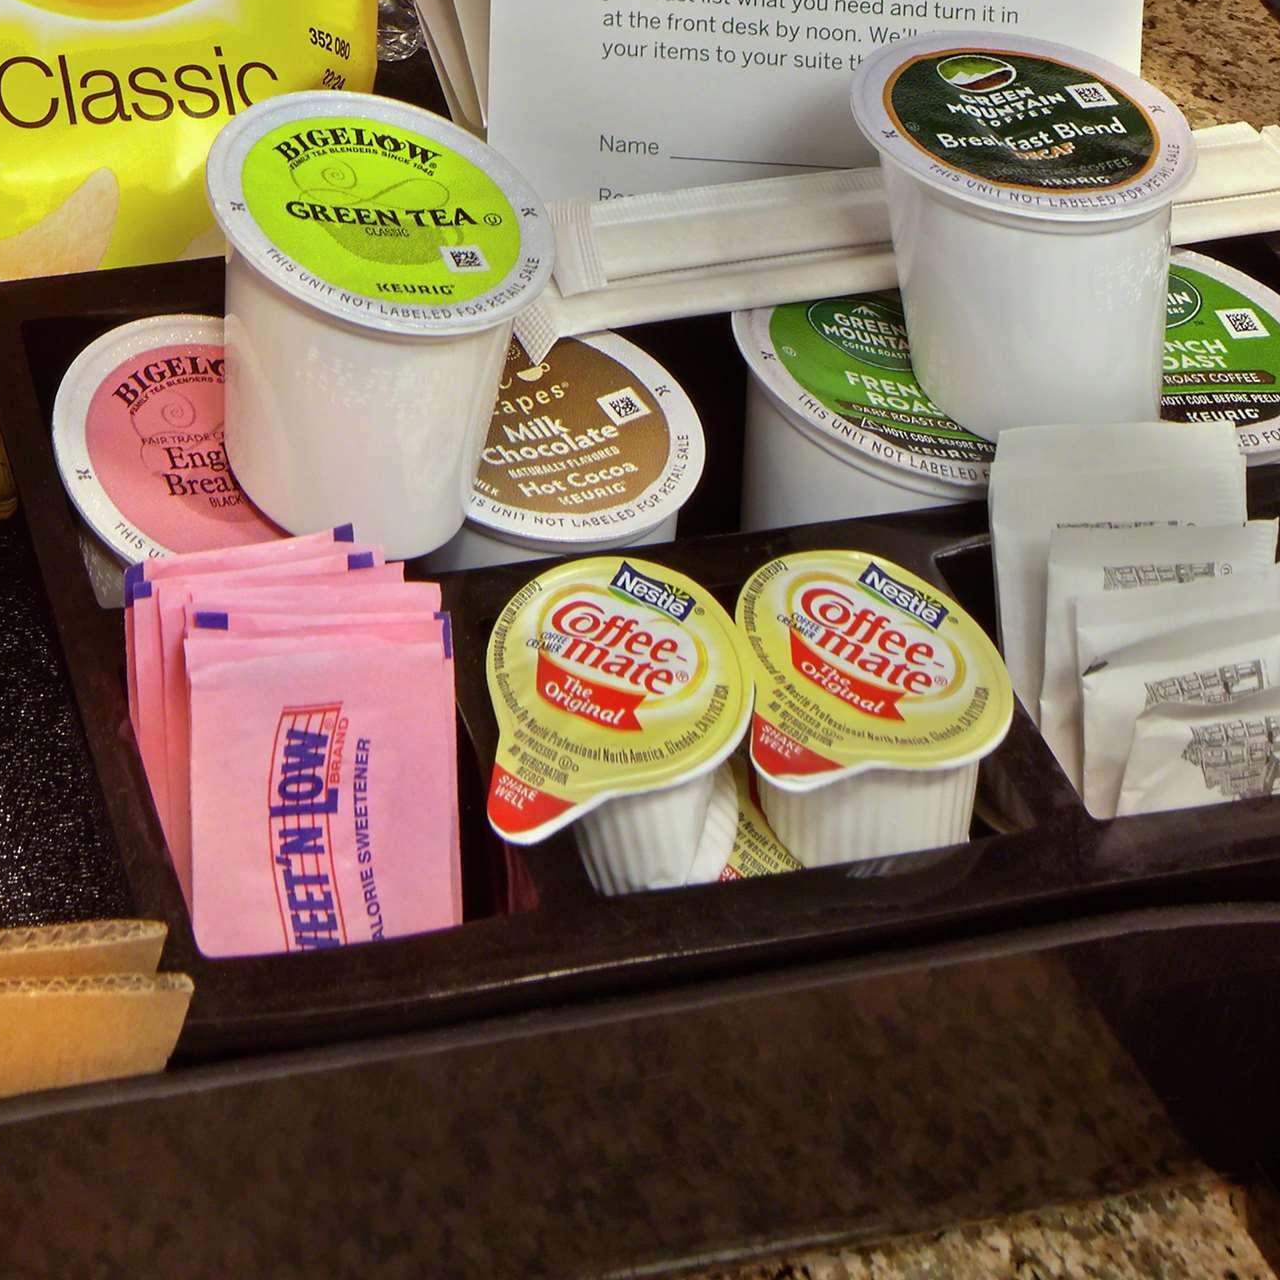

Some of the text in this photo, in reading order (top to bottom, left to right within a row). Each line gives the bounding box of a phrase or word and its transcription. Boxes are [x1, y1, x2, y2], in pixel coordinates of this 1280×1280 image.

[602, 10, 862, 43] at the front desk by noon.
[890, 1, 928, 18] and
[934, 2, 976, 21] turn
[982, 4, 996, 23] it
[1001, 6, 1019, 24] in
[308, 27, 351, 61] 352 080
[601, 41, 843, 70] your items to your suite
[946, 92, 1068, 118] MOUNTAIN
[959, 86, 1036, 108] GREEN
[1052, 116, 1127, 140] Blend
[272, 126, 442, 164] BIGELOW
[600, 134, 660, 156] Name
[285, 200, 478, 228] GREEN TEA
[266, 246, 541, 320] THIS UNIT NOT LABELED FOR RETAIL SALE
[376, 282, 452, 296] KEURIG
[833, 312, 907, 337] GREEN
[1164, 372, 1262, 385] ROAST COFFEE
[1187, 394, 1214, 405] COOL
[1215, 393, 1252, 405] BEFORE
[502, 415, 569, 444] Milk
[891, 410, 935, 428] ROAST
[169, 432, 212, 445] TRADE
[480, 424, 620, 467] Chocolate
[508, 445, 621, 480] NATURALLY FLAVORED
[518, 462, 639, 499] Hot Cocoa
[558, 483, 624, 507] KEURIG
[616, 570, 688, 620] Nestlé
[865, 570, 939, 624] Nestlé
[551, 600, 688, 663] Coffee-
[776, 613, 817, 640] CREAMER
[791, 611, 821, 634] COFFEE
[801, 587, 945, 668] Coffee-
[561, 637, 675, 695] mate
[815, 627, 933, 695] mate
[819, 663, 851, 687] The
[563, 674, 594, 698] The
[800, 659, 885, 714] Original
[544, 680, 625, 725] Original
[328, 717, 350, 785] BRAND
[548, 728, 602, 760] Professional
[759, 734, 792, 758] WELL
[761, 722, 803, 756] SHAKE
[268, 727, 339, 819] LOW
[497, 773, 537, 802] SHAKE
[352, 736, 372, 865] SWEETENER
[494, 786, 526, 810] WELL
